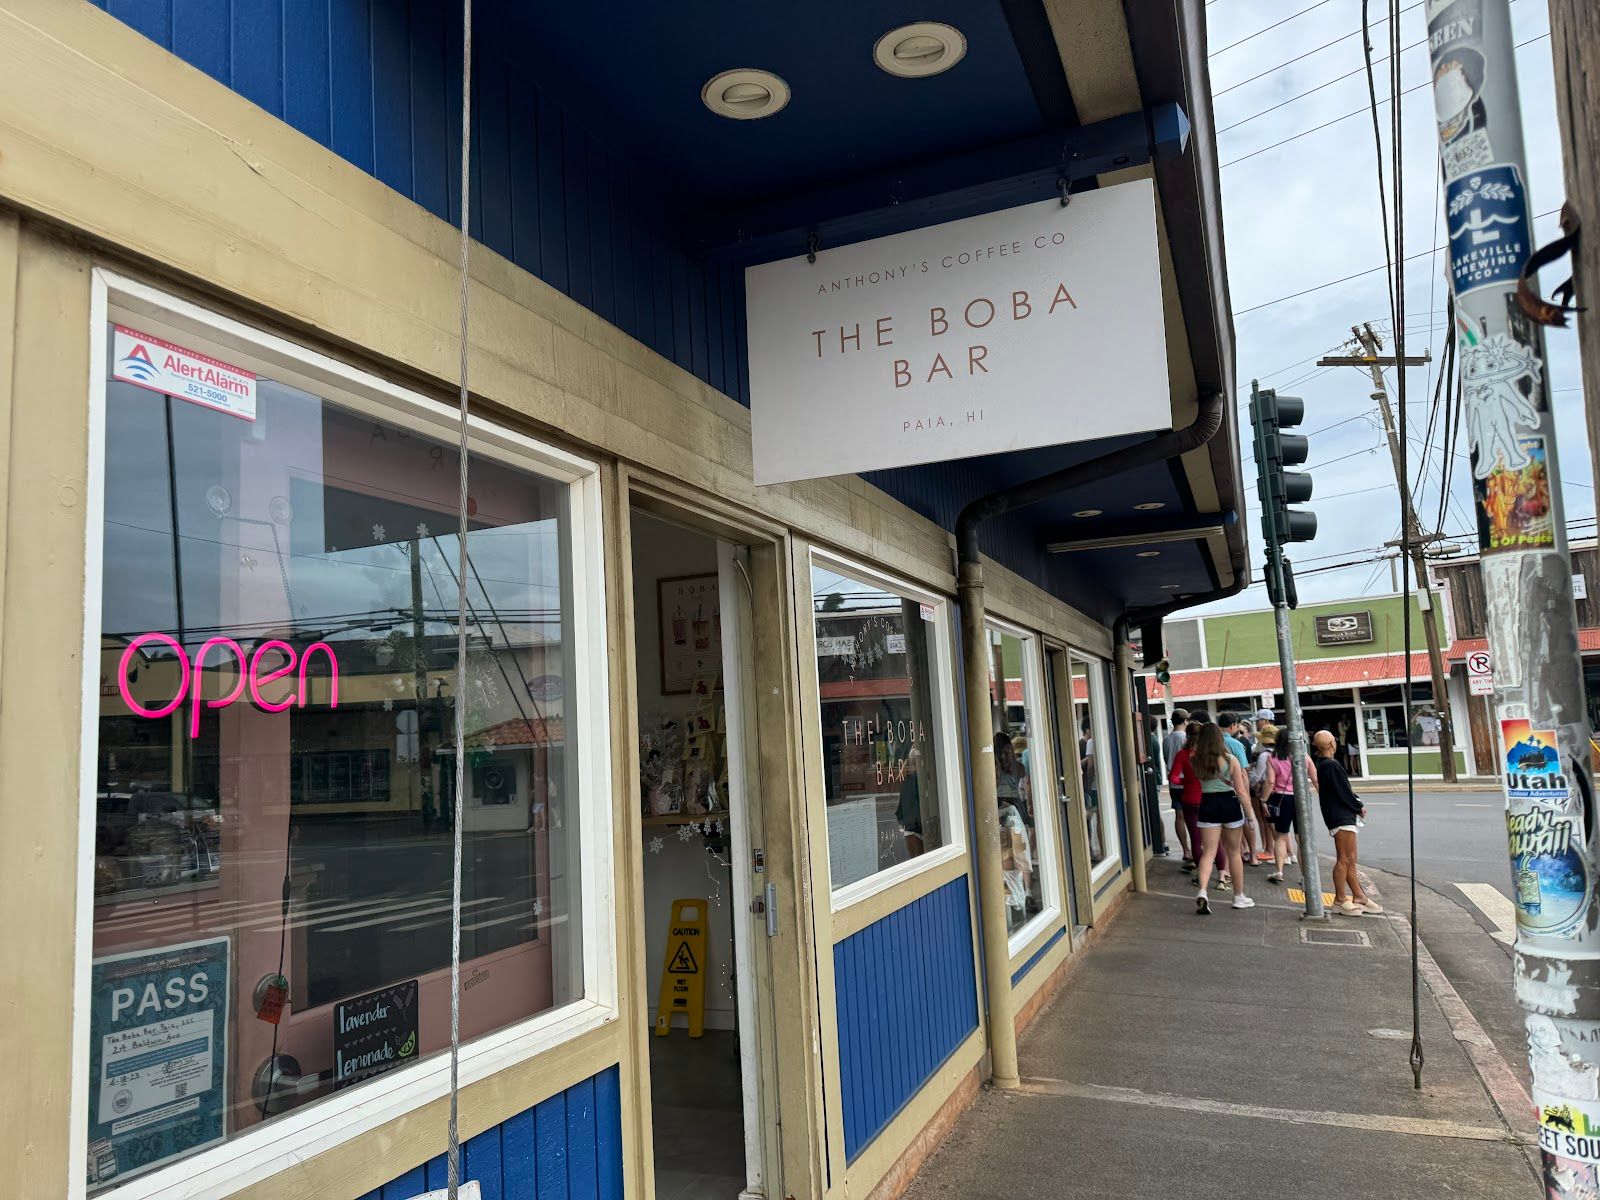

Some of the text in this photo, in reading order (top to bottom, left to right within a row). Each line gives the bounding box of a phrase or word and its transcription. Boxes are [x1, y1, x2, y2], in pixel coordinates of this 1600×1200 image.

[817, 232, 1066, 296] ANTHONY'S COFFEE CO
[1453, 243, 1521, 270] LAKEVILLE
[1456, 254, 1517, 279] BREWING
[811, 282, 1079, 358] THE BOBA
[163, 354, 250, 397] AlertAlarm
[893, 345, 990, 389] BAR
[187, 383, 228, 403] 521-5000
[902, 409, 985, 433] PAIA, HI
[842, 720, 926, 746] THE BOBA
[875, 758, 905, 786] BAR
[1507, 772, 1567, 789] Utah
[672, 927, 700, 937] CAUTION
[111, 971, 209, 1022] PASS
